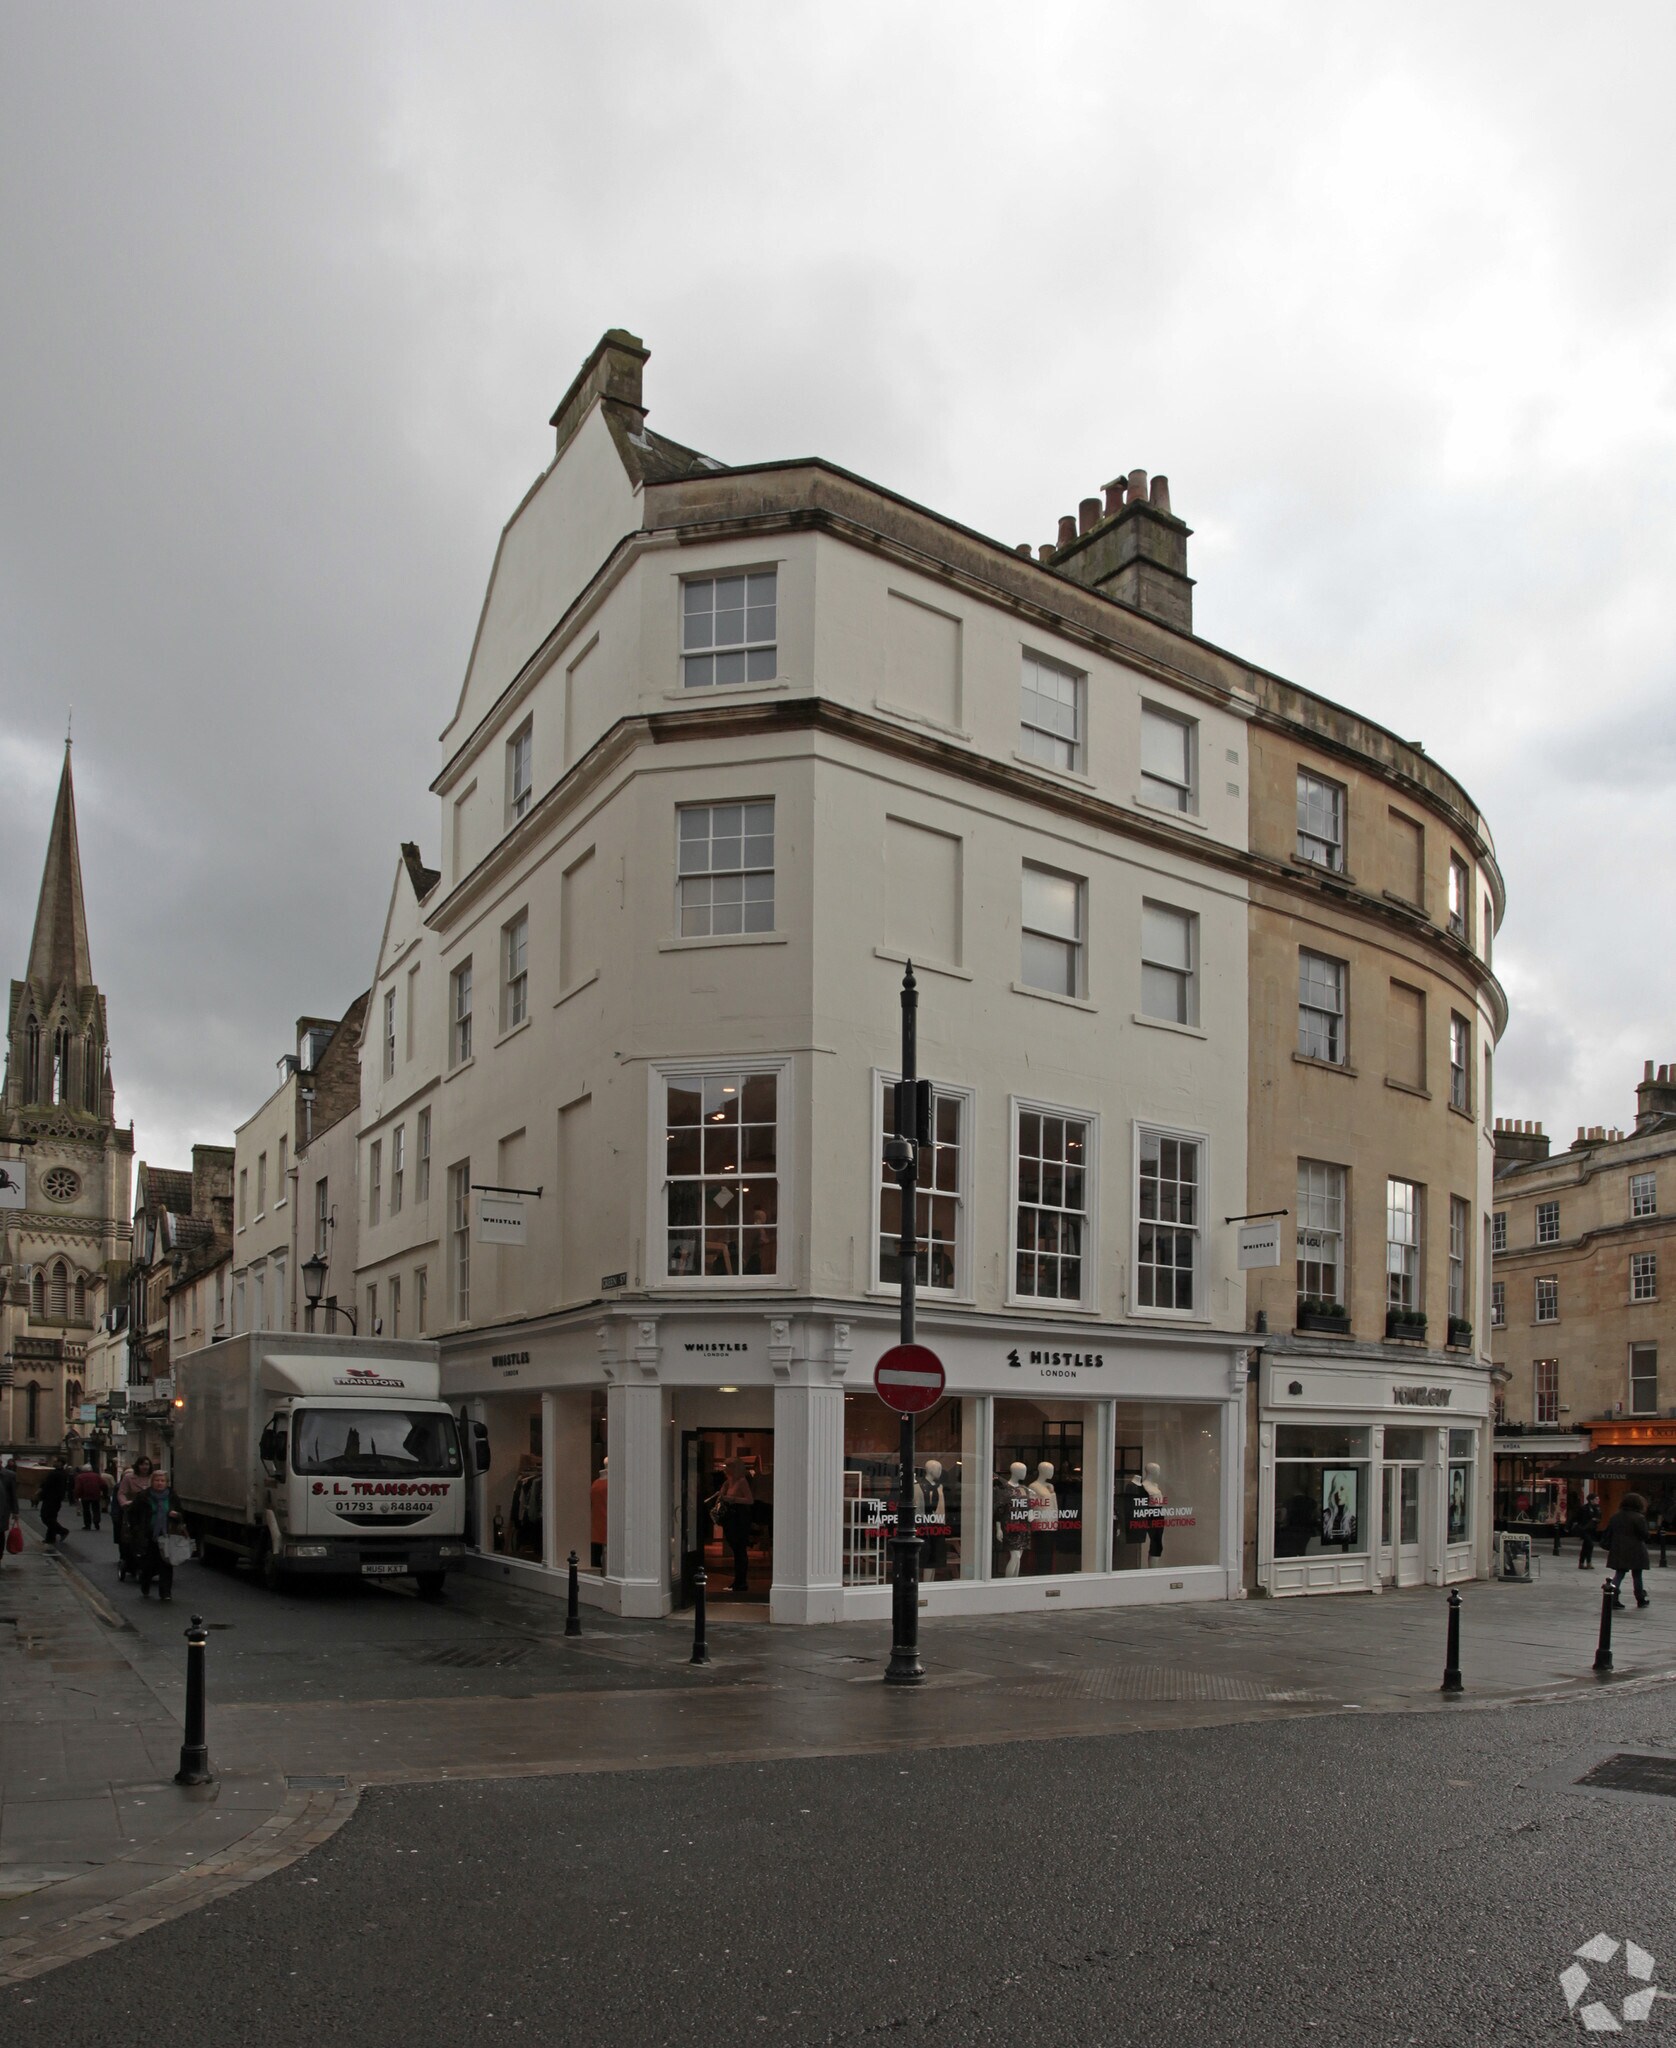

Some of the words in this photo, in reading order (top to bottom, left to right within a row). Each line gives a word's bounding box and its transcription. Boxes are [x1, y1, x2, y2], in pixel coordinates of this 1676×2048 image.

[483, 1217, 521, 1225] WHISTLES
[1243, 1242, 1274, 1250] WHISTLES
[684, 1343, 748, 1351] WHISTLES
[492, 1351, 530, 1367] WHISTLES
[1040, 1369, 1077, 1378] LONDON
[335, 1378, 404, 1387] TRANSPORT
[312, 1482, 329, 1496] S.
[333, 1483, 348, 1496] L.
[351, 1483, 451, 1496] TRANSPORT
[336, 1502, 373, 1511] 01793
[391, 1502, 433, 1511] 848404
[867, 1501, 887, 1512] THE
[1011, 1498, 1027, 1508] THE
[1028, 1498, 1050, 1507] SALE
[1133, 1497, 1148, 1507] THE
[1149, 1496, 1168, 1505] SALE
[1010, 1510, 1059, 1520] HAPPENING
[1059, 1509, 1079, 1519] NOW
[1133, 1508, 1175, 1518] HAPPENING
[1175, 1507, 1193, 1516] NOW
[867, 1514, 922, 1524] HAPPEG
[923, 1514, 945, 1524] NOW
[1129, 1519, 1150, 1530] FINAL
[1151, 1518, 1196, 1528] REDUCTIONS
[1031, 1520, 1082, 1531] REDUCTIONS
[864, 1528, 890, 1537] FINAL
[388, 1565, 403, 1573] KXT
